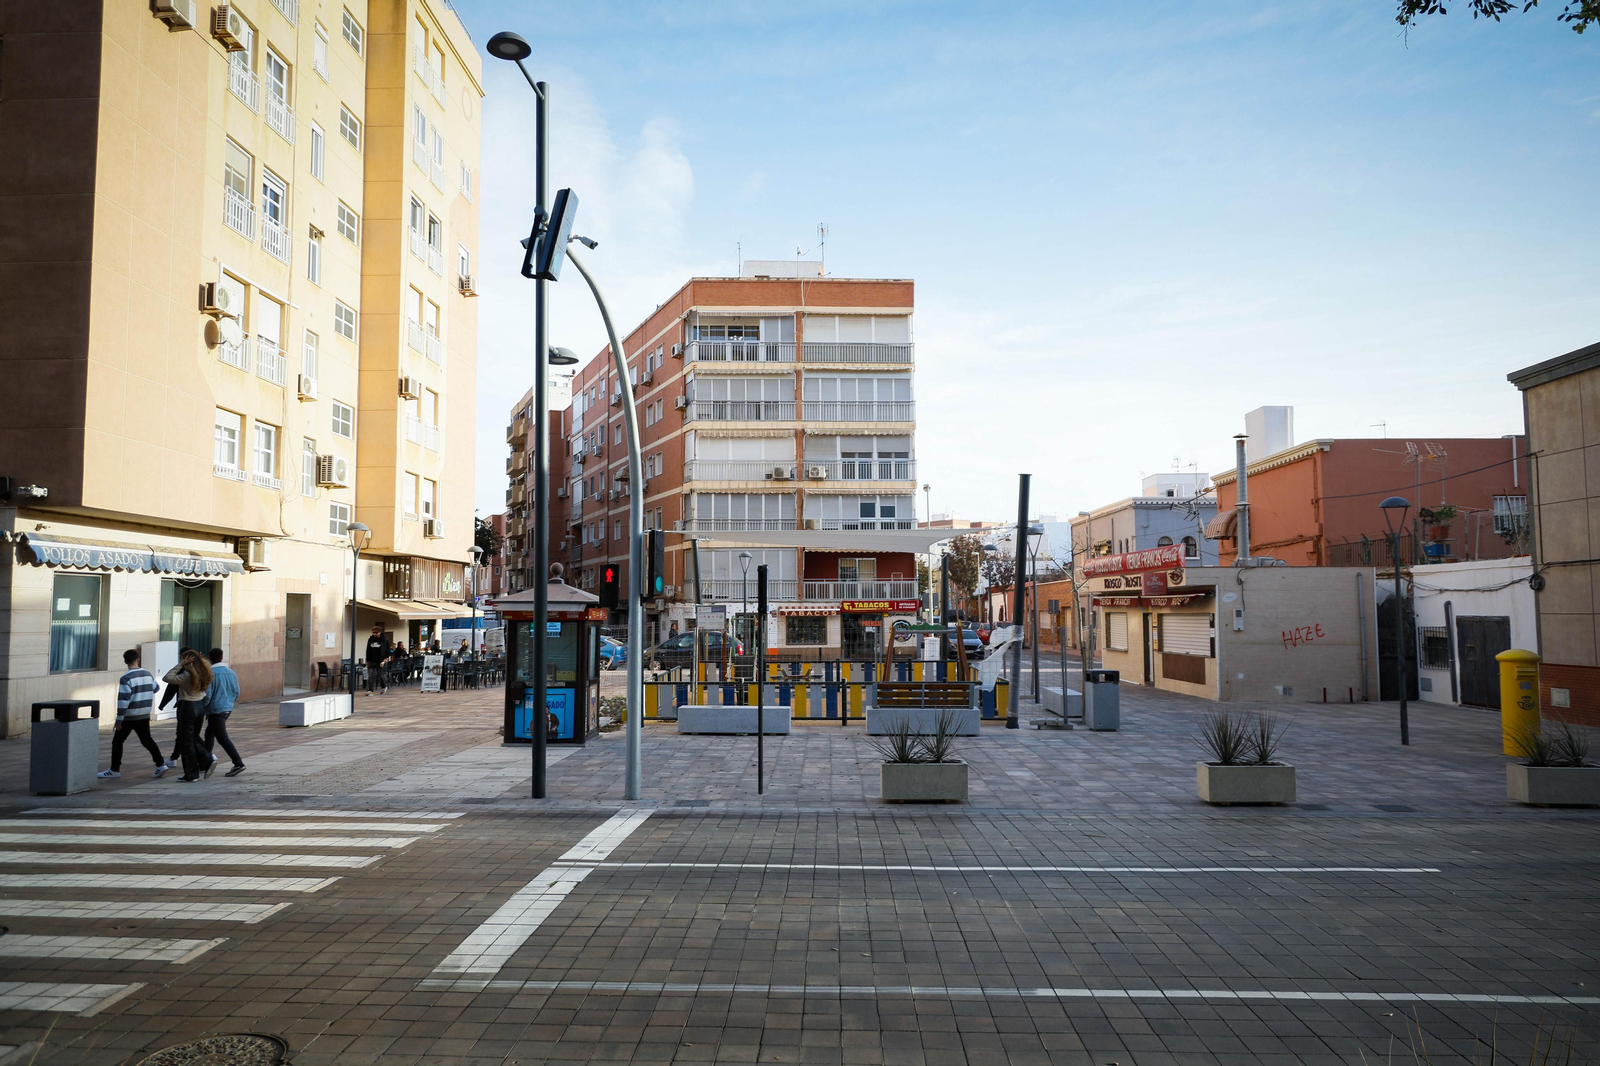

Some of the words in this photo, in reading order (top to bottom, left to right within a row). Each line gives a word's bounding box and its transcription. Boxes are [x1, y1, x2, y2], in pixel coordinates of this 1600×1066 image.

[41, 546, 91, 563] POLLOS
[97, 551, 144, 566] ASADOS
[1127, 552, 1141, 569] TIENDA
[1141, 549, 1162, 567] FRANCIS
[205, 560, 228, 572] BAR
[1125, 576, 1142, 588] ROSIT
[1113, 598, 1131, 606] FRANCIS
[1281, 623, 1325, 650] HAZE
[525, 700, 534, 709] BIE
